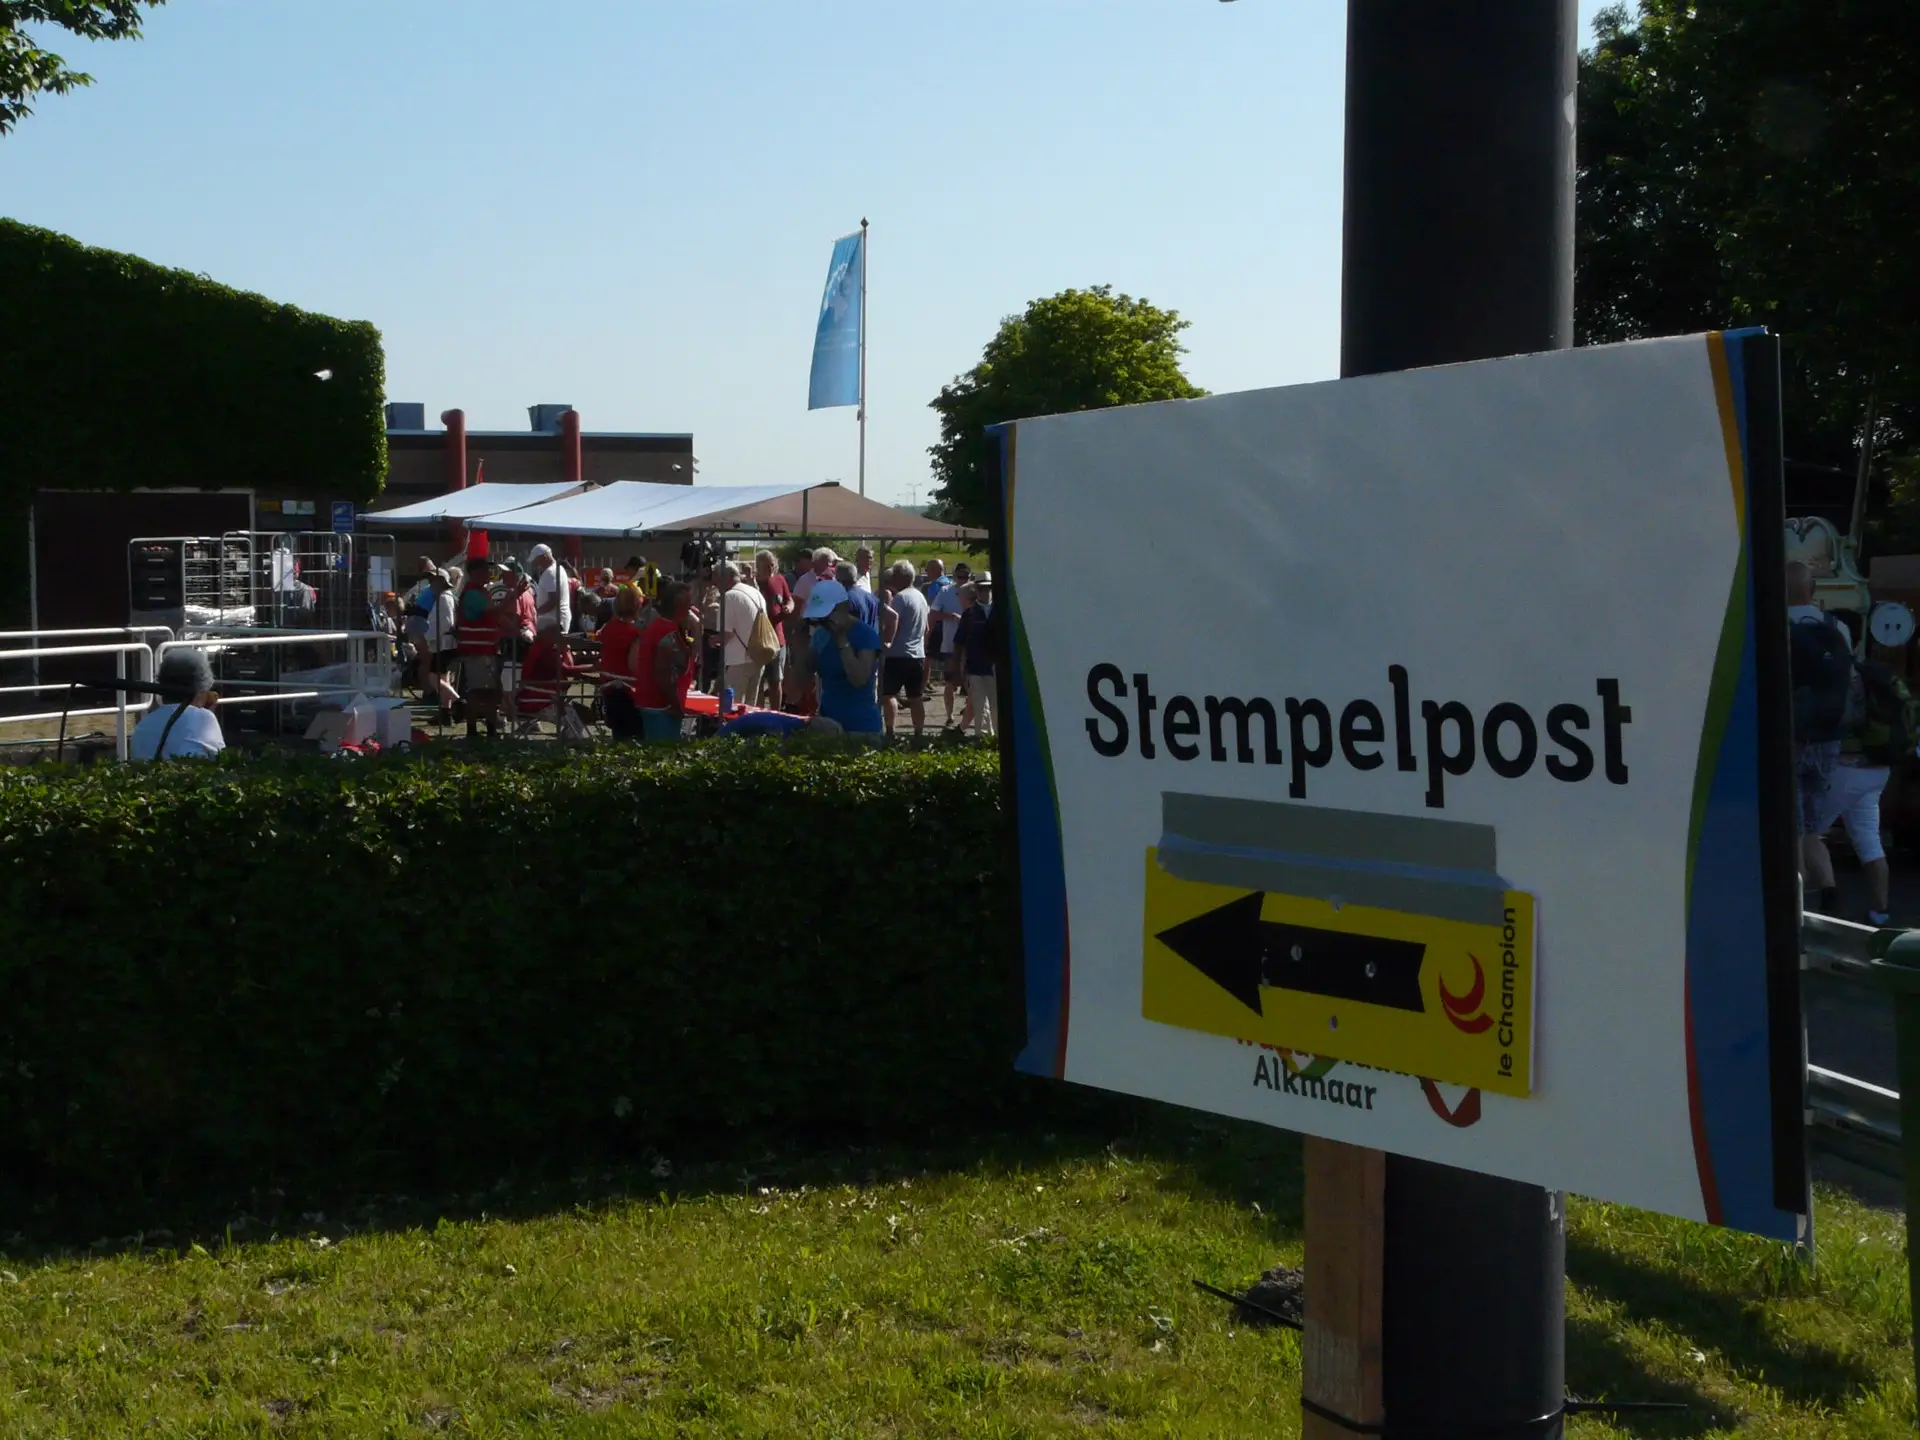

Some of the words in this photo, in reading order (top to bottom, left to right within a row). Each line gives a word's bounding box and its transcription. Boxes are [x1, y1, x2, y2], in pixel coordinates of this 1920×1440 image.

[1085, 662, 1632, 808] Stempelpost
[1498, 907, 1519, 1048] Champion
[1253, 1054, 1377, 1110] Alkmaar
[1497, 1052, 1513, 1078] le
